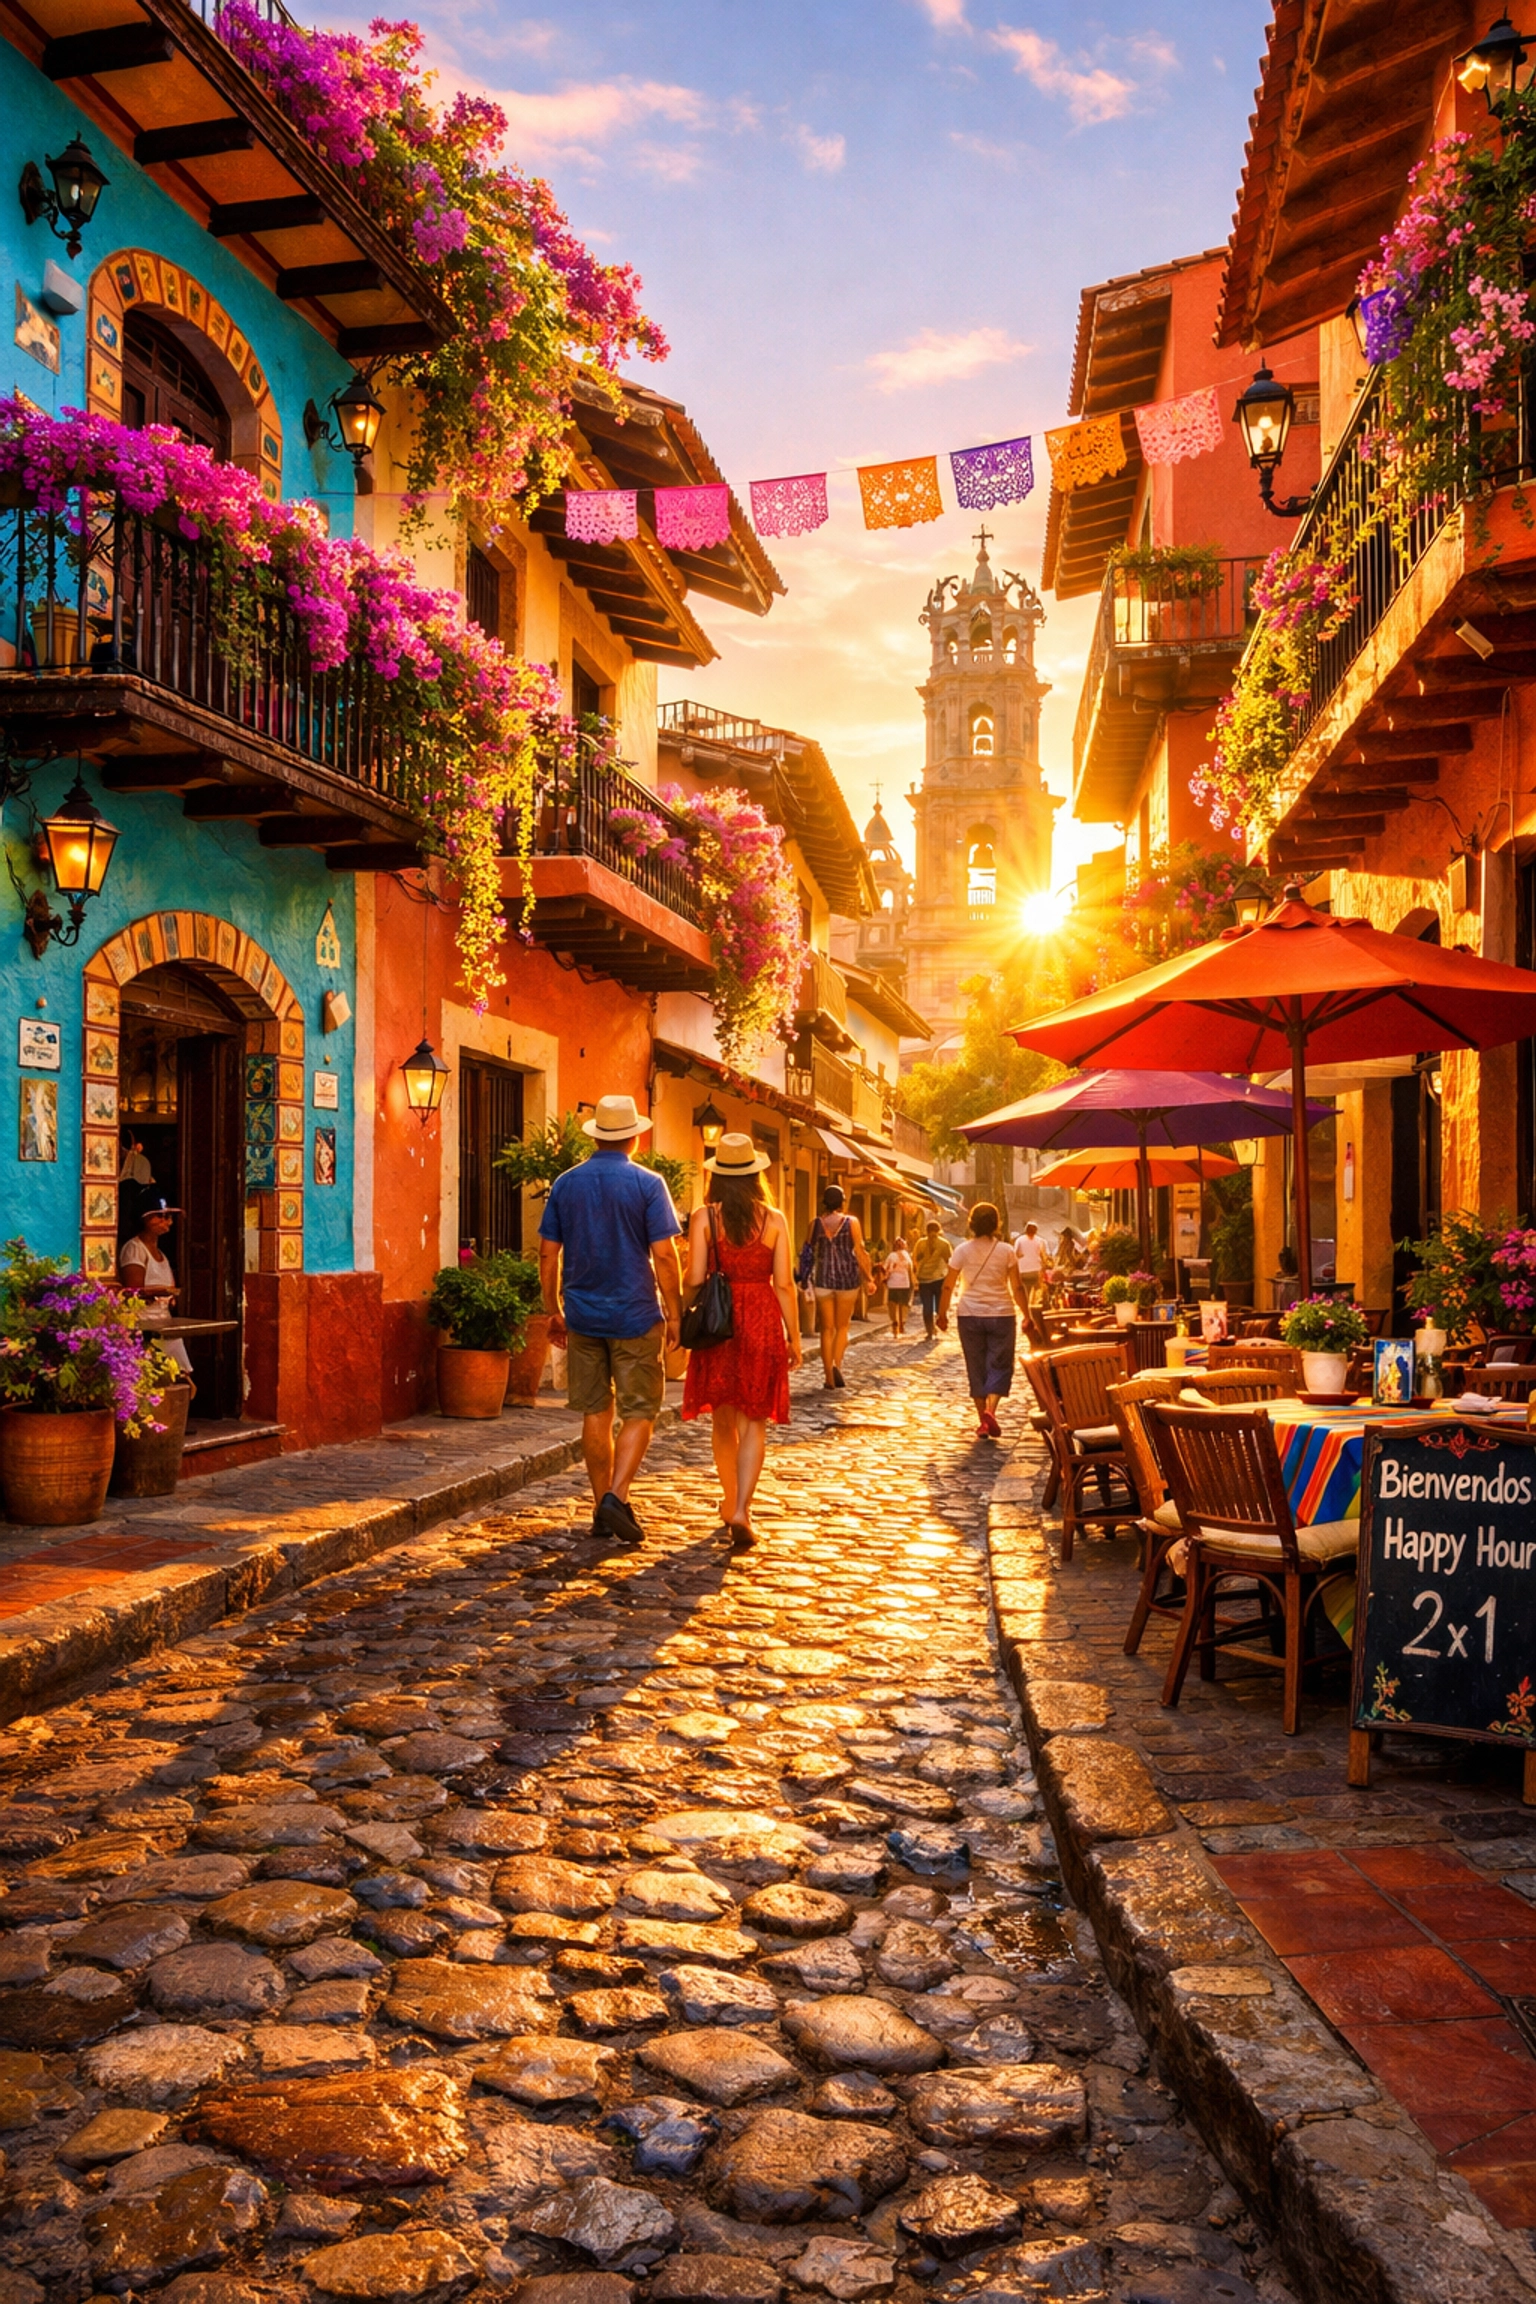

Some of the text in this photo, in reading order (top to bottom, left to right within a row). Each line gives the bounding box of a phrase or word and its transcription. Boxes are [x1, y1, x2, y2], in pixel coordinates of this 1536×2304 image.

[1379, 1459, 1532, 1504] Bienvendos
[1384, 1516, 1536, 1575] Happy Hour
[1402, 1590, 1497, 1664] 2x1
